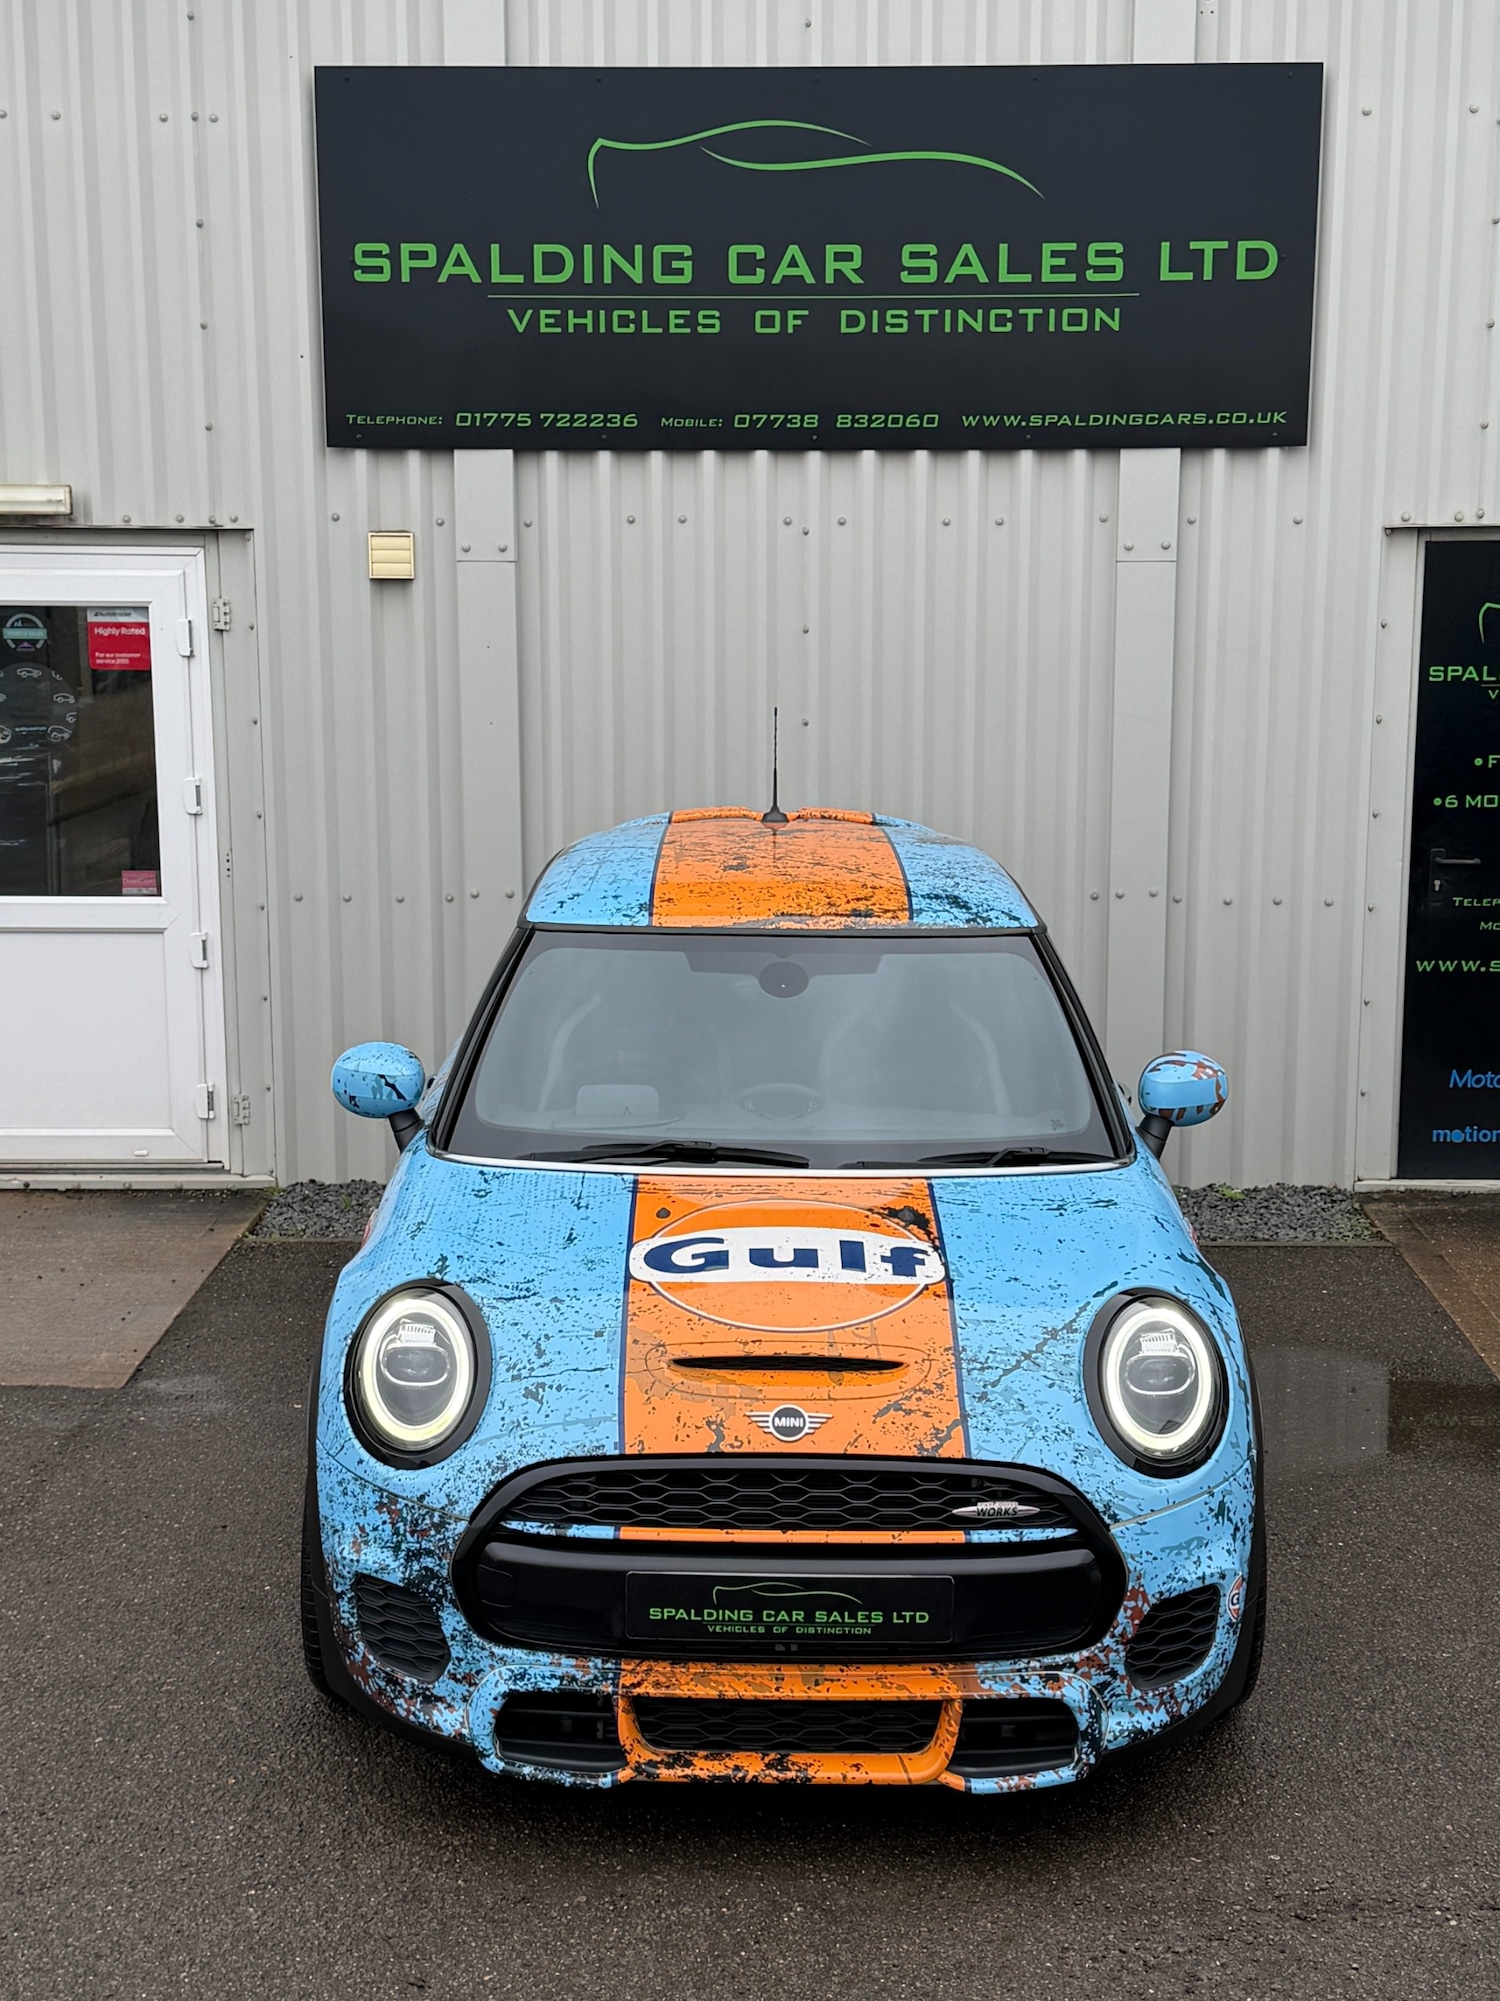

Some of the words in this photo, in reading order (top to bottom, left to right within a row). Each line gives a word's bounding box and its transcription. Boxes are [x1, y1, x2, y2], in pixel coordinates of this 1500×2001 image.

[352, 241, 694, 286] SPALDING
[727, 243, 864, 286] CAR
[899, 241, 1125, 285] SALES
[1158, 239, 1279, 282] LTD
[507, 308, 722, 335] VEHICLES
[753, 308, 810, 335] OF
[839, 307, 1121, 335] DISTINCTION
[455, 411, 532, 427] 01775
[540, 412, 638, 428] 722236
[733, 413, 819, 429] 07738
[835, 413, 939, 429] 832060
[961, 411, 1287, 427] WWW.SPALDINGCARS.CO.UK
[94, 626, 121, 637] Highly
[121, 626, 146, 636] Rated
[1428, 665, 1500, 682] SPAL
[1444, 794, 1459, 809] 6
[1465, 794, 1499, 809] MO
[643, 1237, 930, 1277] Gulf
[773, 1416, 804, 1428] MINI
[976, 1507, 1018, 1517] WORKS
[649, 1608, 753, 1622] SPALDING
[762, 1610, 805, 1623] CAR
[814, 1611, 884, 1624] SALES
[892, 1611, 930, 1624] LTD
[707, 1624, 766, 1634] VEHICLES
[773, 1625, 789, 1635] OF
[795, 1625, 872, 1635] DISTINCTION
